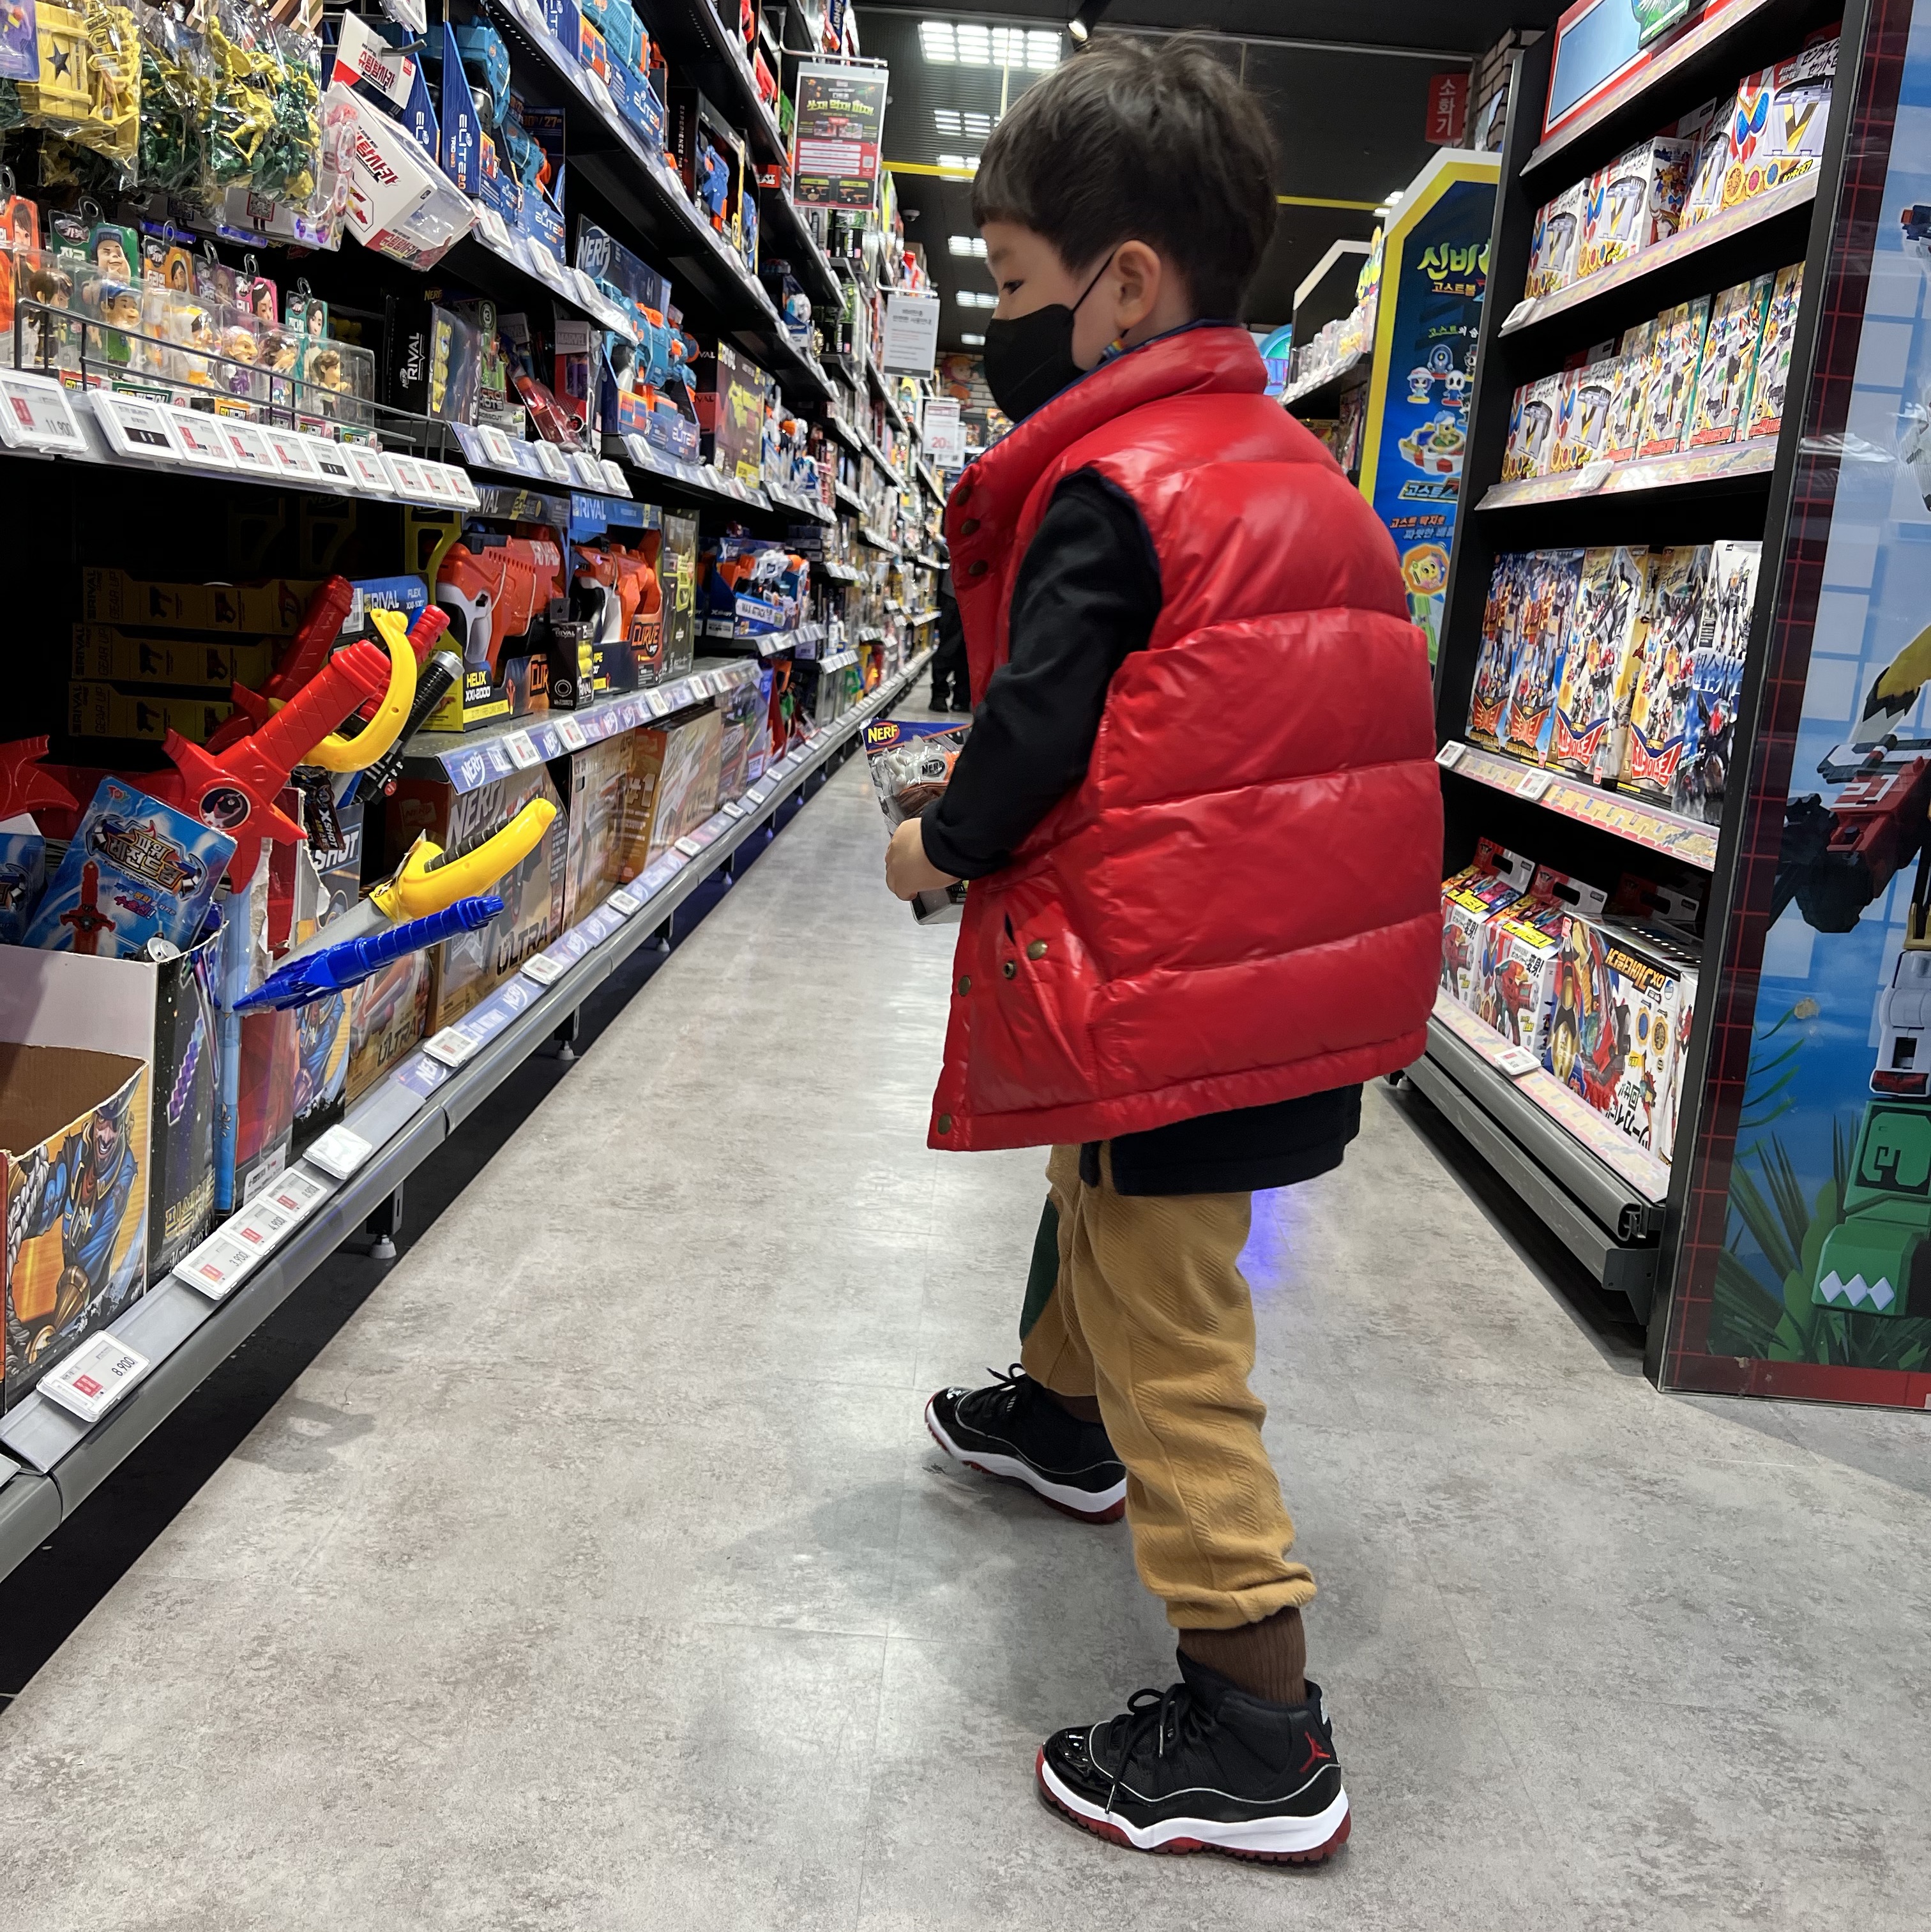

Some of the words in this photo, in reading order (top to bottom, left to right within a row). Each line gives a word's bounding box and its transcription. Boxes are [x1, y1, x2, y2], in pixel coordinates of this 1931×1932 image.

[1436, 79, 1455, 136] 소화기
[458, 114, 467, 174] ELITE
[576, 236, 610, 271] NERF
[424, 289, 443, 301] NERF
[557, 333, 586, 345] MARVEL
[407, 332, 420, 381] RIVAL
[580, 499, 607, 521] RIVAL
[529, 540, 560, 566] RIVAL
[371, 589, 400, 610] RIVAL
[407, 588, 422, 599] FLEX
[631, 624, 660, 647] CURVE
[467, 671, 487, 688] HELIX
[465, 687, 491, 702] XXI-2000
[868, 724, 898, 743] NERF
[461, 750, 485, 787] NERF
[319, 809, 338, 848] XSHOT
[110, 838, 158, 876] 레전드
[137, 835, 165, 860] 파워
[103, 860, 121, 873] Power
[123, 870, 144, 884] Legend
[144, 881, 163, 893] Sword
[159, 865, 181, 885] 검
[497, 915, 547, 977] ULTRA
[111, 1357, 135, 1376] 8,900
